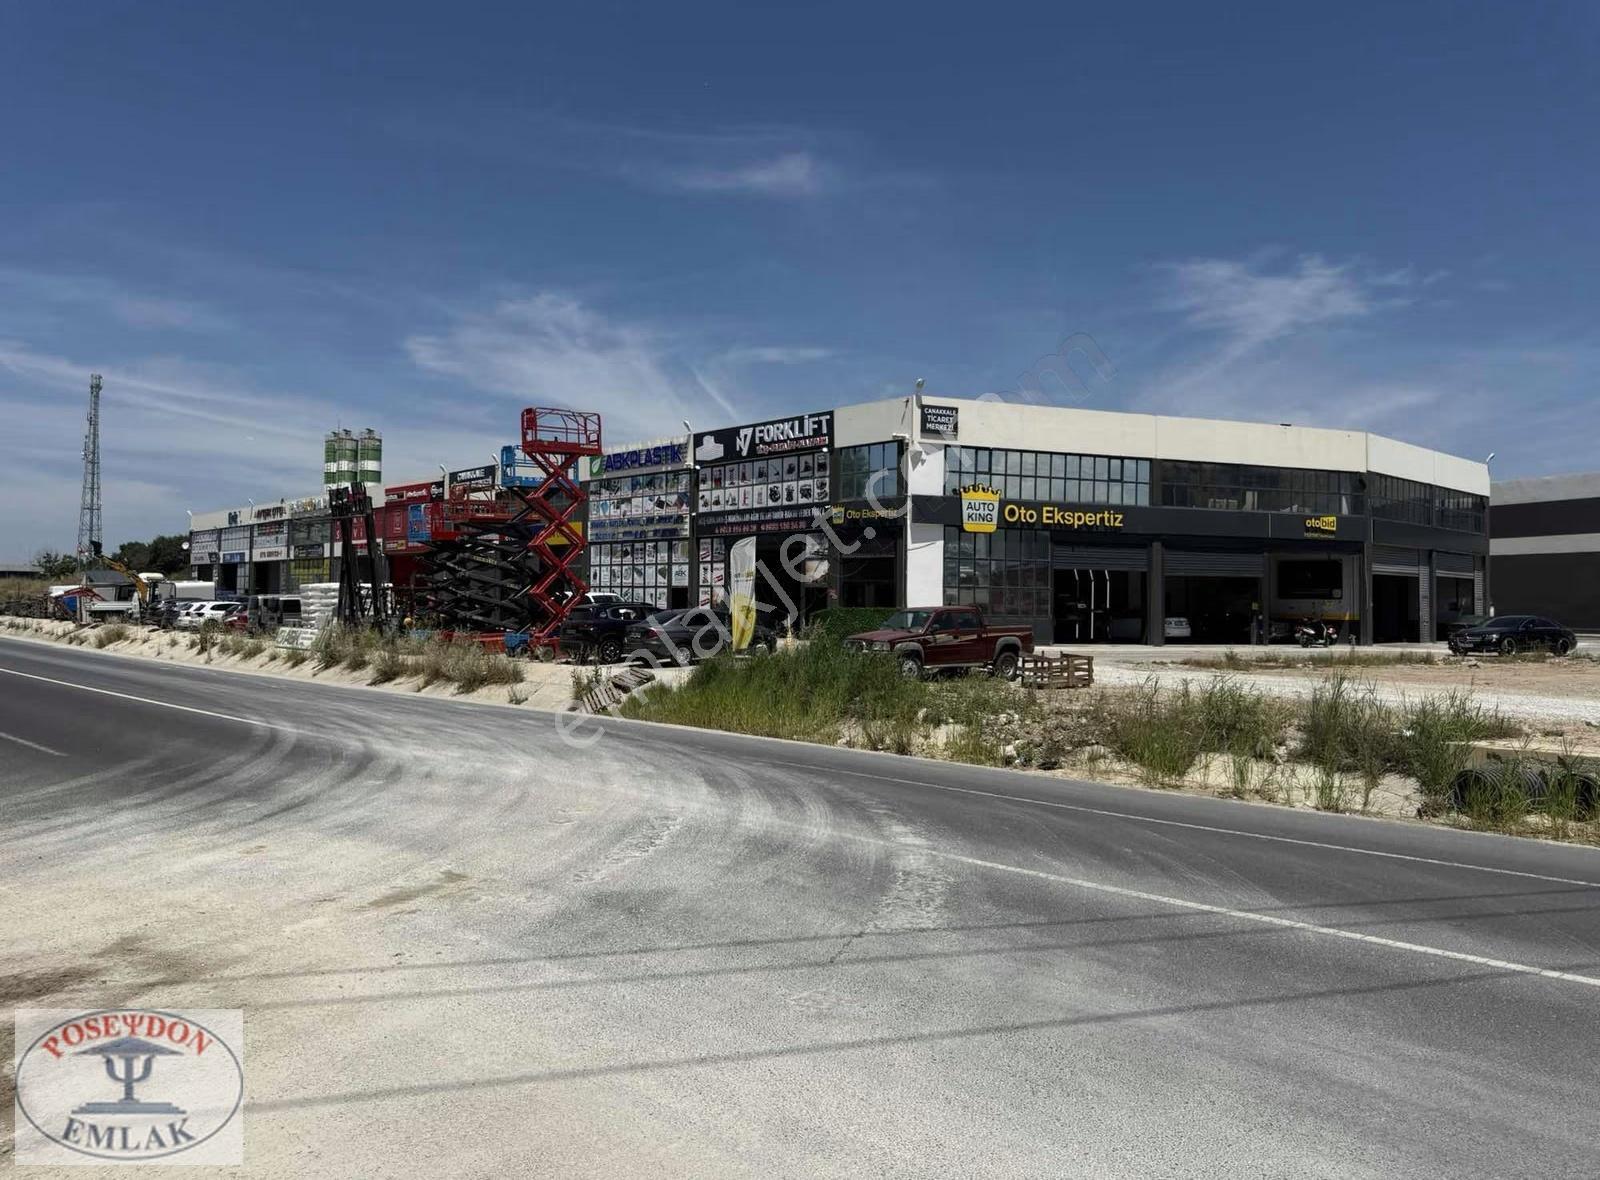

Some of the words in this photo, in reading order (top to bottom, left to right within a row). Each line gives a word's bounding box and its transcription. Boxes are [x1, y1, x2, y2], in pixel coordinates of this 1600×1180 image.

[755, 415, 830, 444] FORKLİFT
[966, 502, 995, 512] AUTO
[846, 509, 861, 519] Oto
[967, 513, 993, 523] KING
[1004, 504, 1037, 523] Oto
[1042, 506, 1124, 529] Ekspertiz
